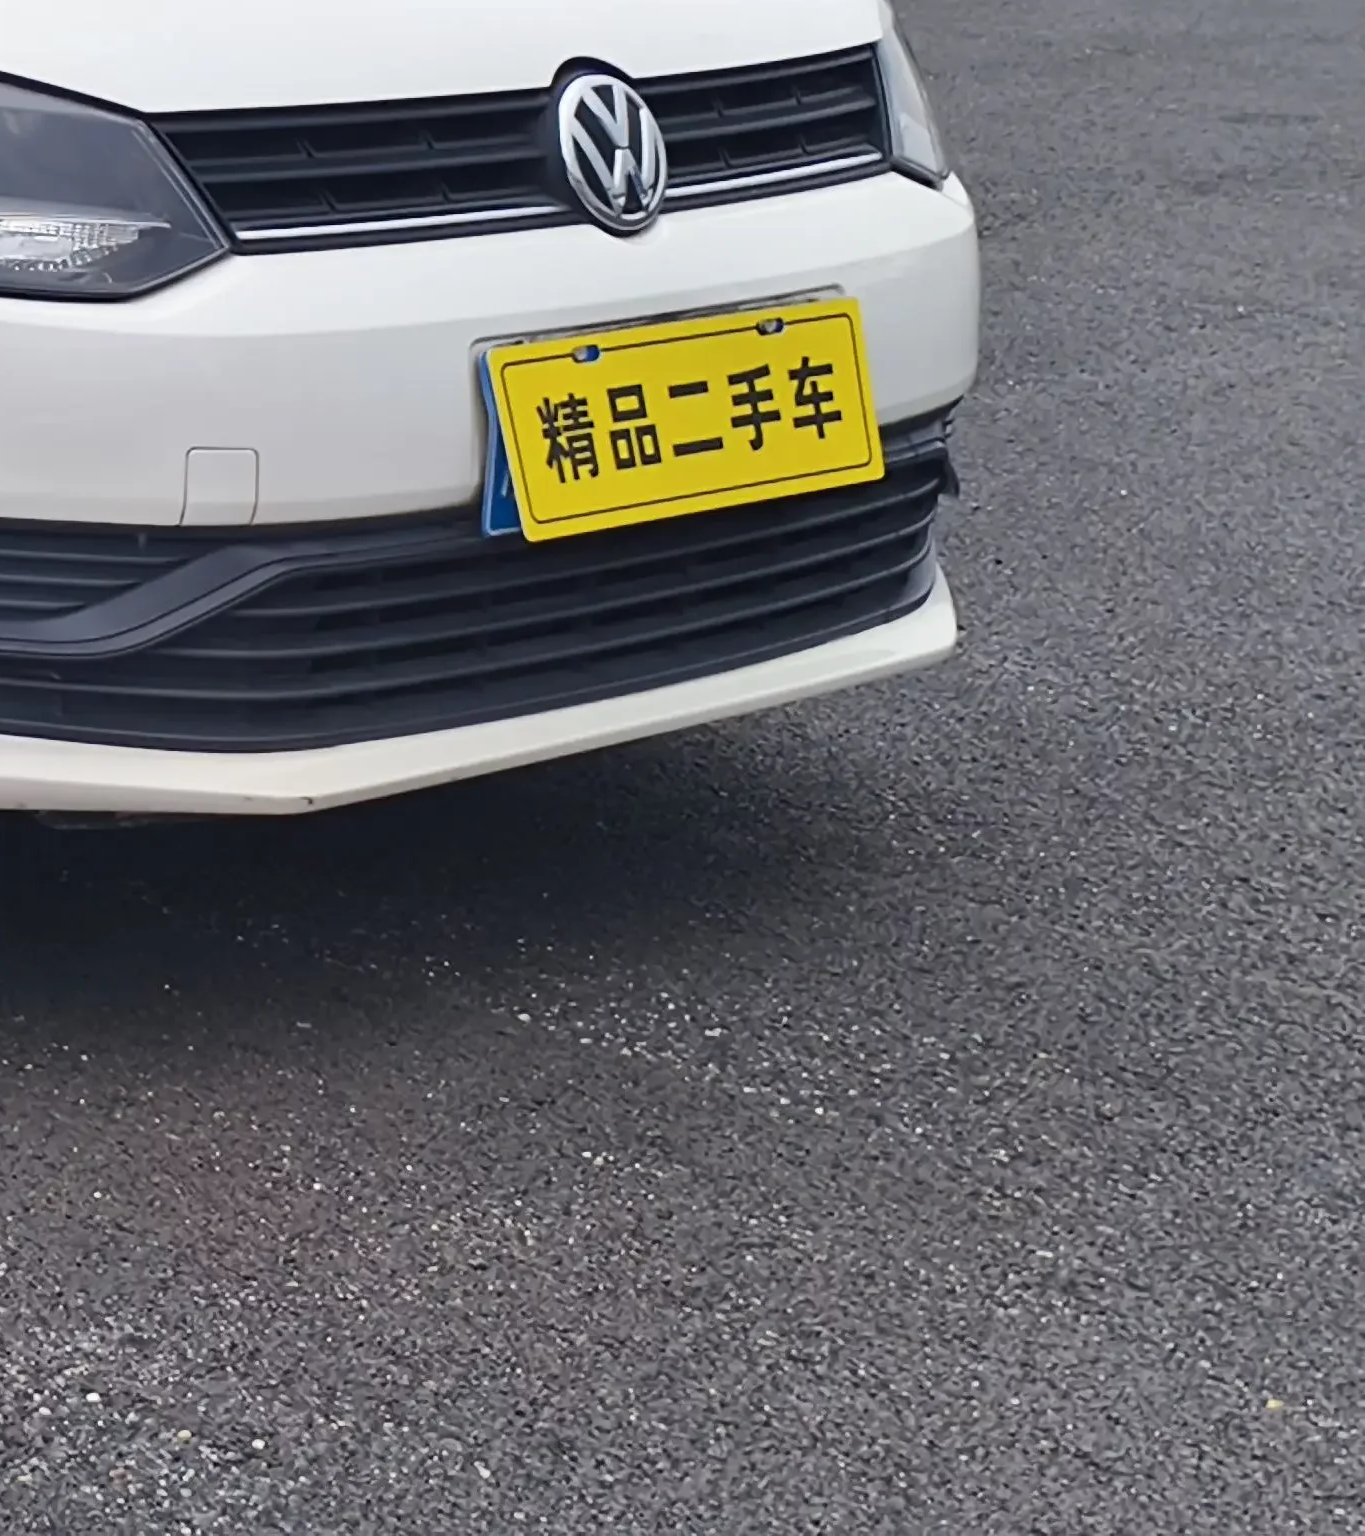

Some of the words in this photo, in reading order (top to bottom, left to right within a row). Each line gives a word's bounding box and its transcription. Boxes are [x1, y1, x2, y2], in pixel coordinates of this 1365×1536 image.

[537, 356, 842, 485] 精品二手车
